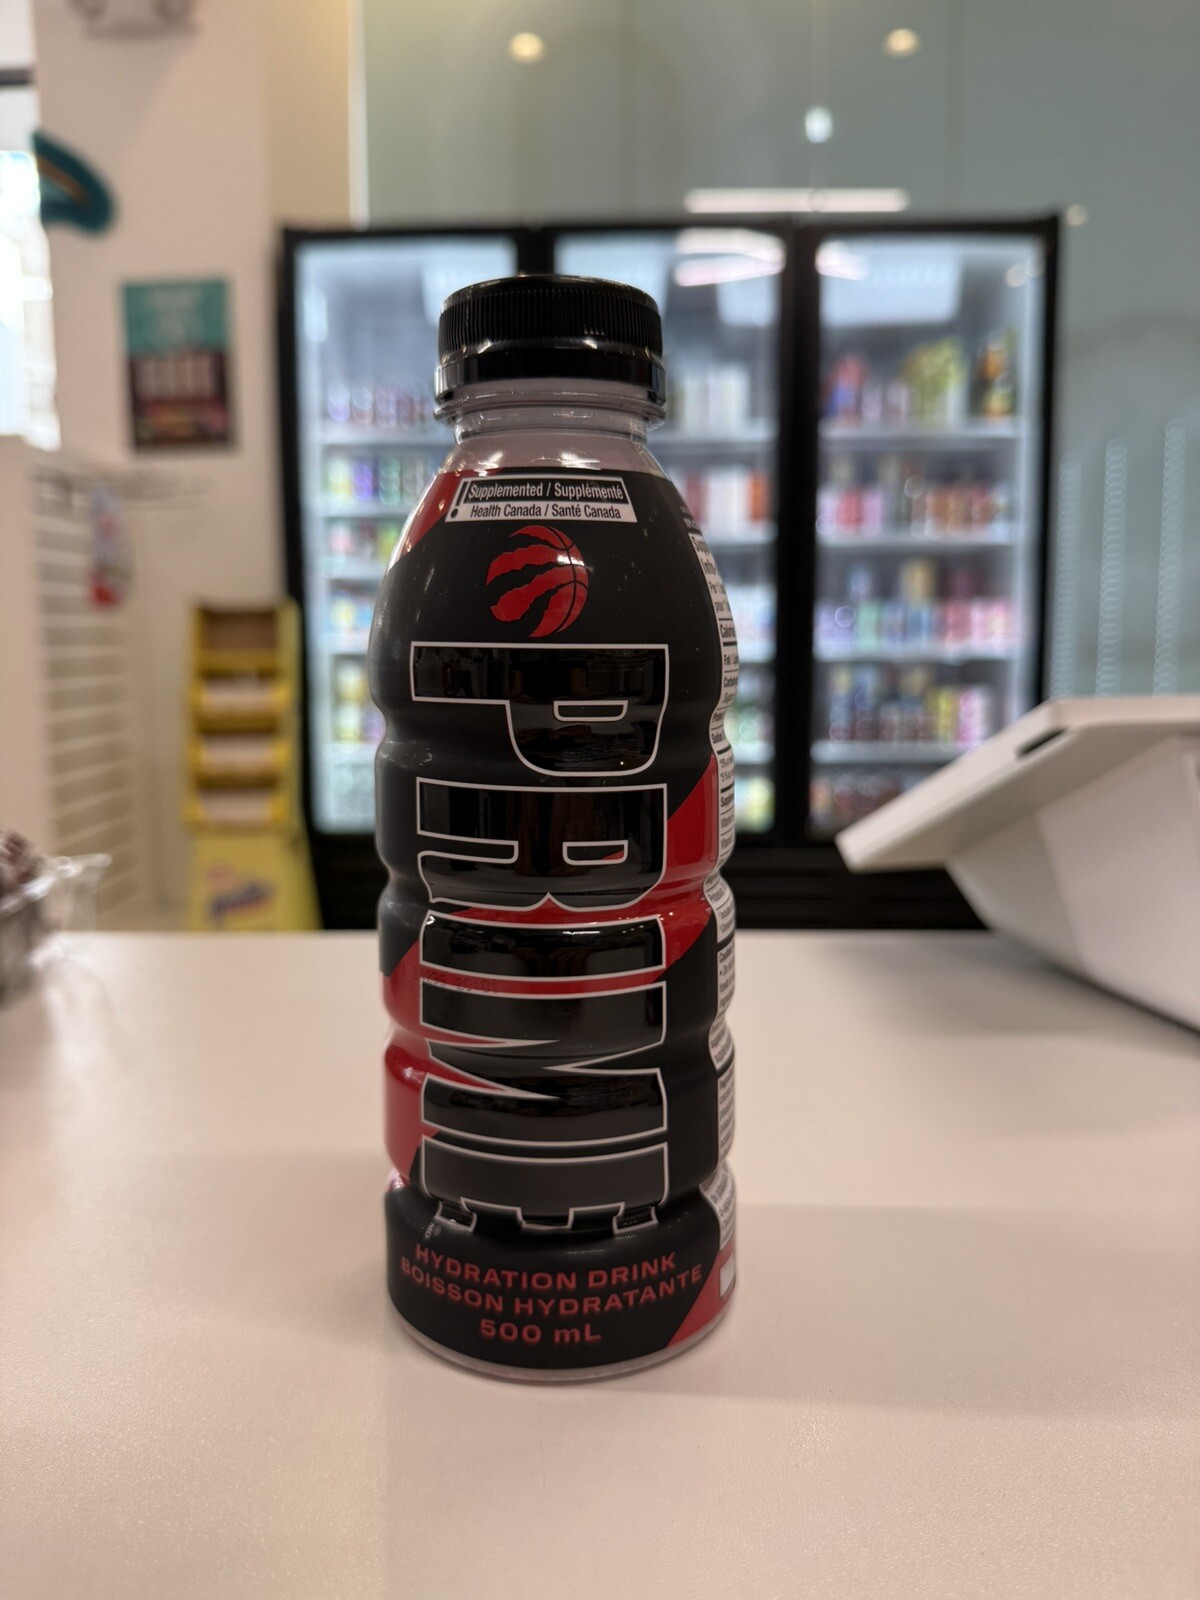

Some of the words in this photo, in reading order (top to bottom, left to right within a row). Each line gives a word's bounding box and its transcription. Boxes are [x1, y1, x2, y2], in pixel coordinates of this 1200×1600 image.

[468, 481, 543, 500] Supplemented
[554, 481, 624, 500] Supplémenté
[470, 504, 501, 518] Health
[503, 503, 542, 517] Canada
[552, 503, 581, 517] Santé
[584, 504, 621, 519] Canada
[410, 641, 669, 1234] PRIME
[415, 1243, 577, 1290] HYDRATION
[588, 1252, 677, 1288] DRINK
[401, 1256, 504, 1313] BOISSON
[514, 1264, 703, 1315] HYDRATANTE
[480, 1317, 543, 1343] 500
[554, 1322, 602, 1343] mL
